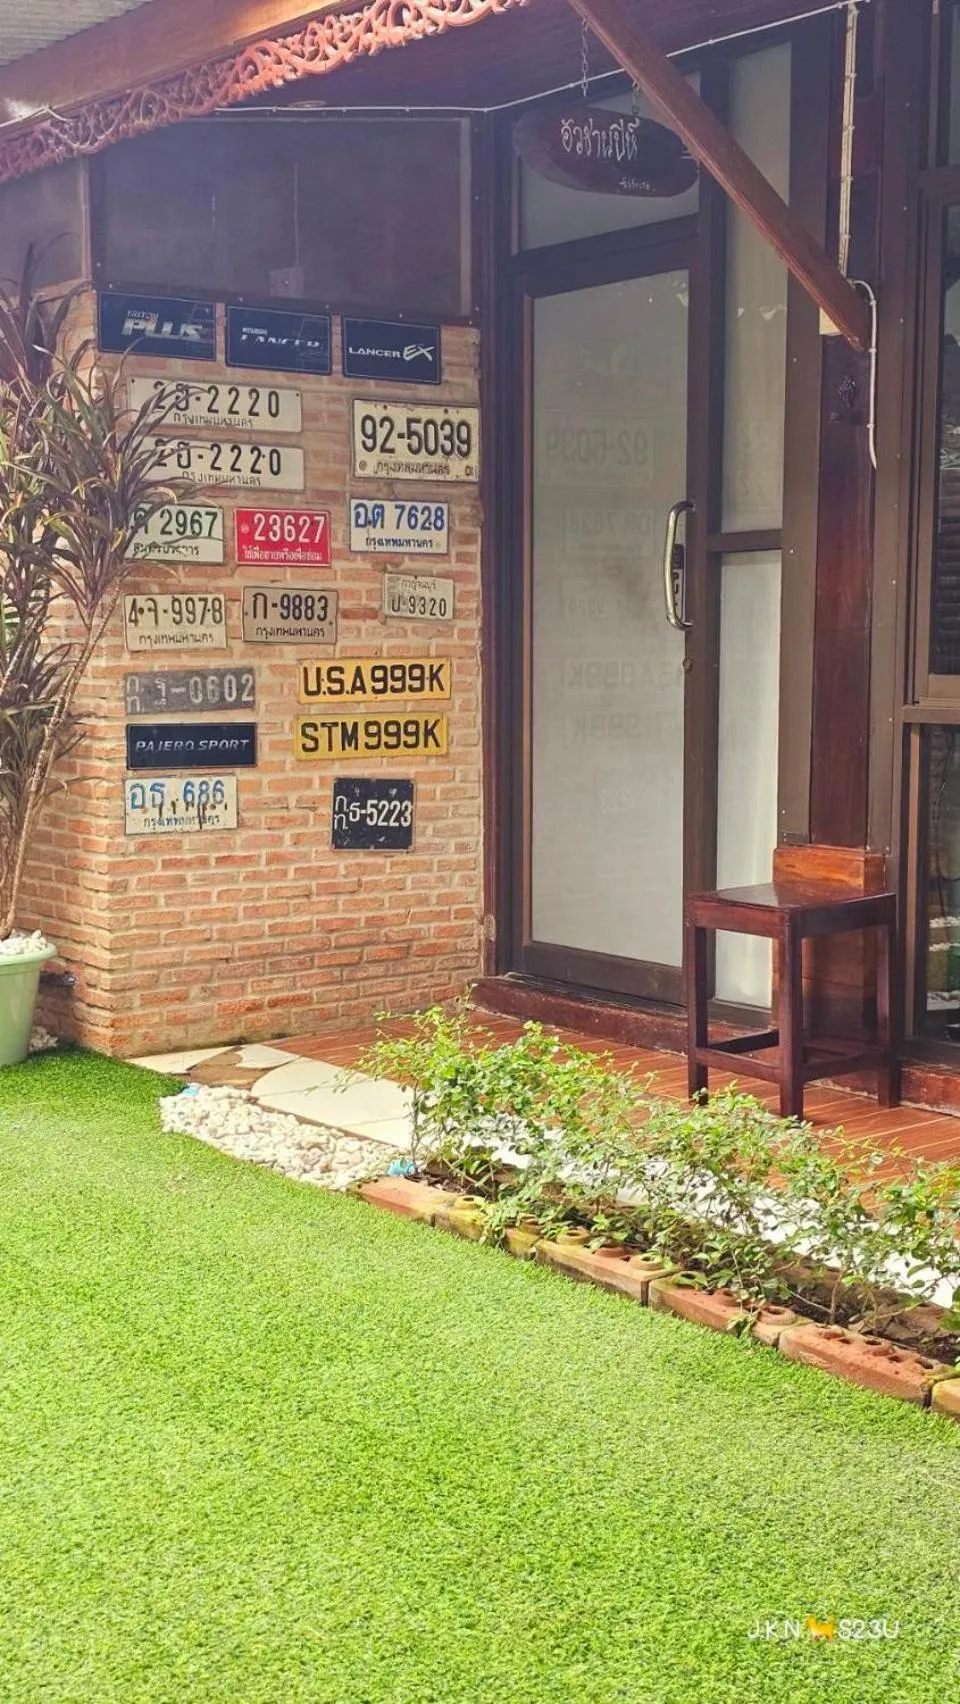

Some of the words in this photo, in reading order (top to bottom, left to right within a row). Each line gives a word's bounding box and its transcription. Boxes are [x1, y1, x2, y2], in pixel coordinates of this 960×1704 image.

[349, 347, 401, 359] LANCER
[403, 344, 435, 361] EX
[360, 414, 472, 458] 92-5039
[159, 508, 218, 537] 2967
[253, 513, 325, 544] 23627
[394, 503, 445, 531] 7628
[255, 625, 326, 640] กรุงเทพมหานคร
[135, 740, 194, 752] PAJERO
[199, 739, 249, 751] SPORT
[182, 779, 225, 806] 686
